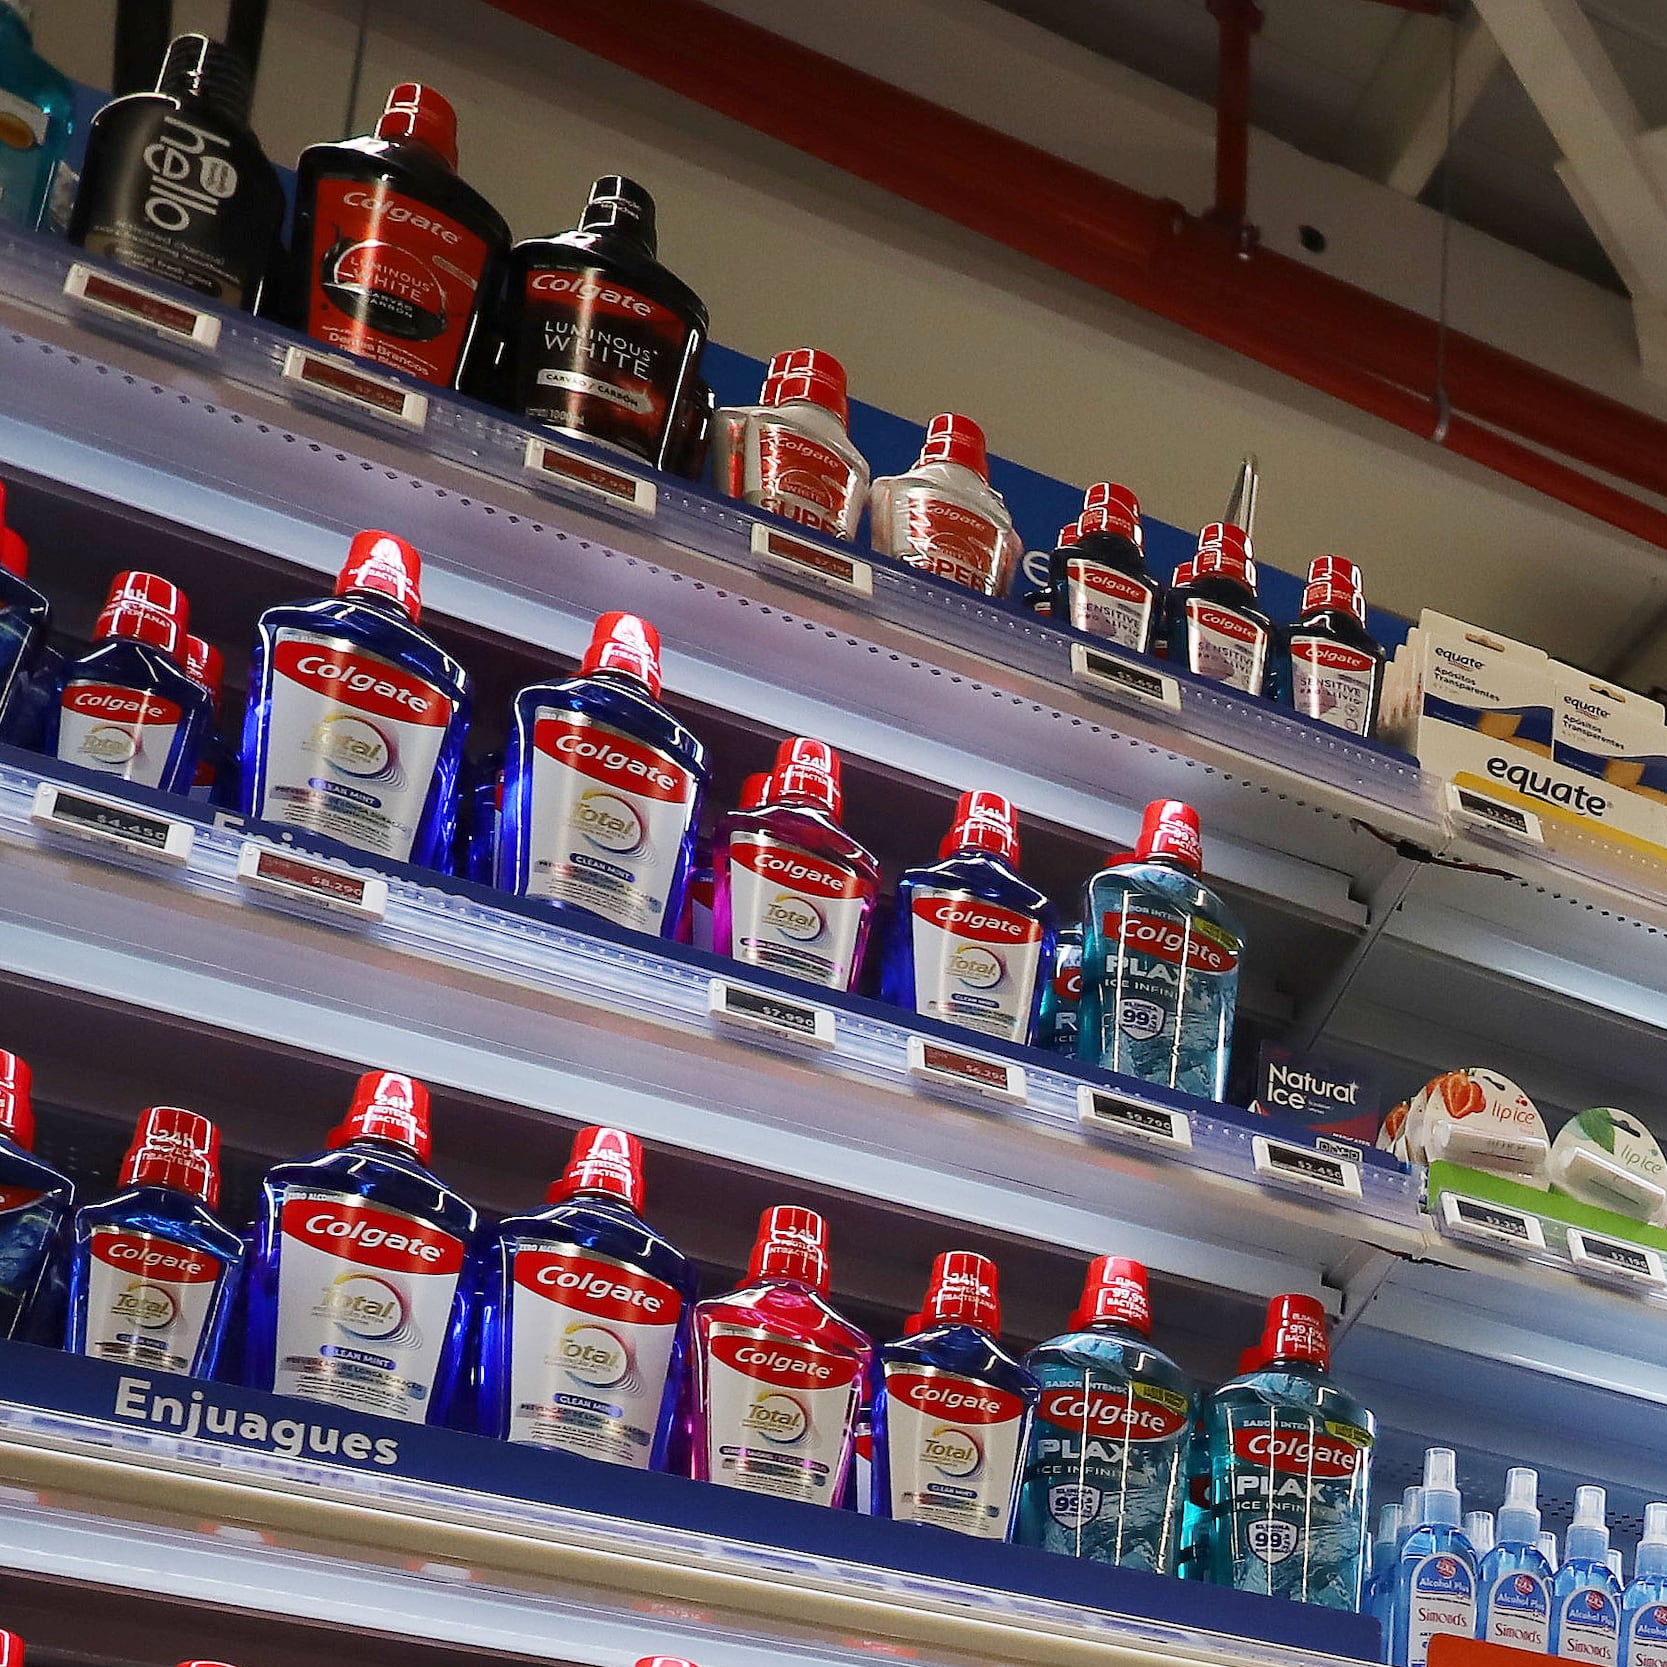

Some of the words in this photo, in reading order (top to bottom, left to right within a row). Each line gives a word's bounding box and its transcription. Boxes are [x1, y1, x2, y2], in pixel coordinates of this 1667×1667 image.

[144, 116, 230, 231] hello
[343, 191, 459, 244] Colgate
[531, 274, 651, 316] Colgate
[545, 321, 652, 362] LUMINOUS
[545, 334, 649, 381] WHITE
[1084, 572, 1140, 598] Colgate
[1202, 612, 1257, 638] Colgate
[1305, 647, 1362, 667] Colgate
[1434, 646, 1484, 670] equate
[296, 655, 429, 713] Colgate
[74, 693, 164, 718] Colgate
[1564, 695, 1610, 719] equate
[555, 735, 677, 791] Colgate
[1487, 756, 1607, 817] equate
[754, 854, 844, 891] Colgate
[766, 905, 816, 927] Total
[935, 907, 1023, 937] Colgate
[1118, 920, 1221, 968] Colgate
[950, 952, 995, 976] Total
[1268, 1064, 1358, 1106] Natural
[1268, 1085, 1305, 1109] Ice
[305, 1213, 445, 1263] Colgate
[108, 1242, 203, 1274] Colgate
[536, 1266, 662, 1313] Colgate
[734, 1347, 832, 1379] Colgate
[748, 1402, 799, 1425] Total
[910, 1383, 1001, 1414] Colgate
[1050, 1394, 1166, 1432] Colgate
[114, 1376, 399, 1465] Enjuagues
[924, 1438, 973, 1462] Total
[1038, 1438, 1131, 1468] PLAX
[1248, 1433, 1355, 1469] Colgate
[1237, 1475, 1325, 1502] PLAX
